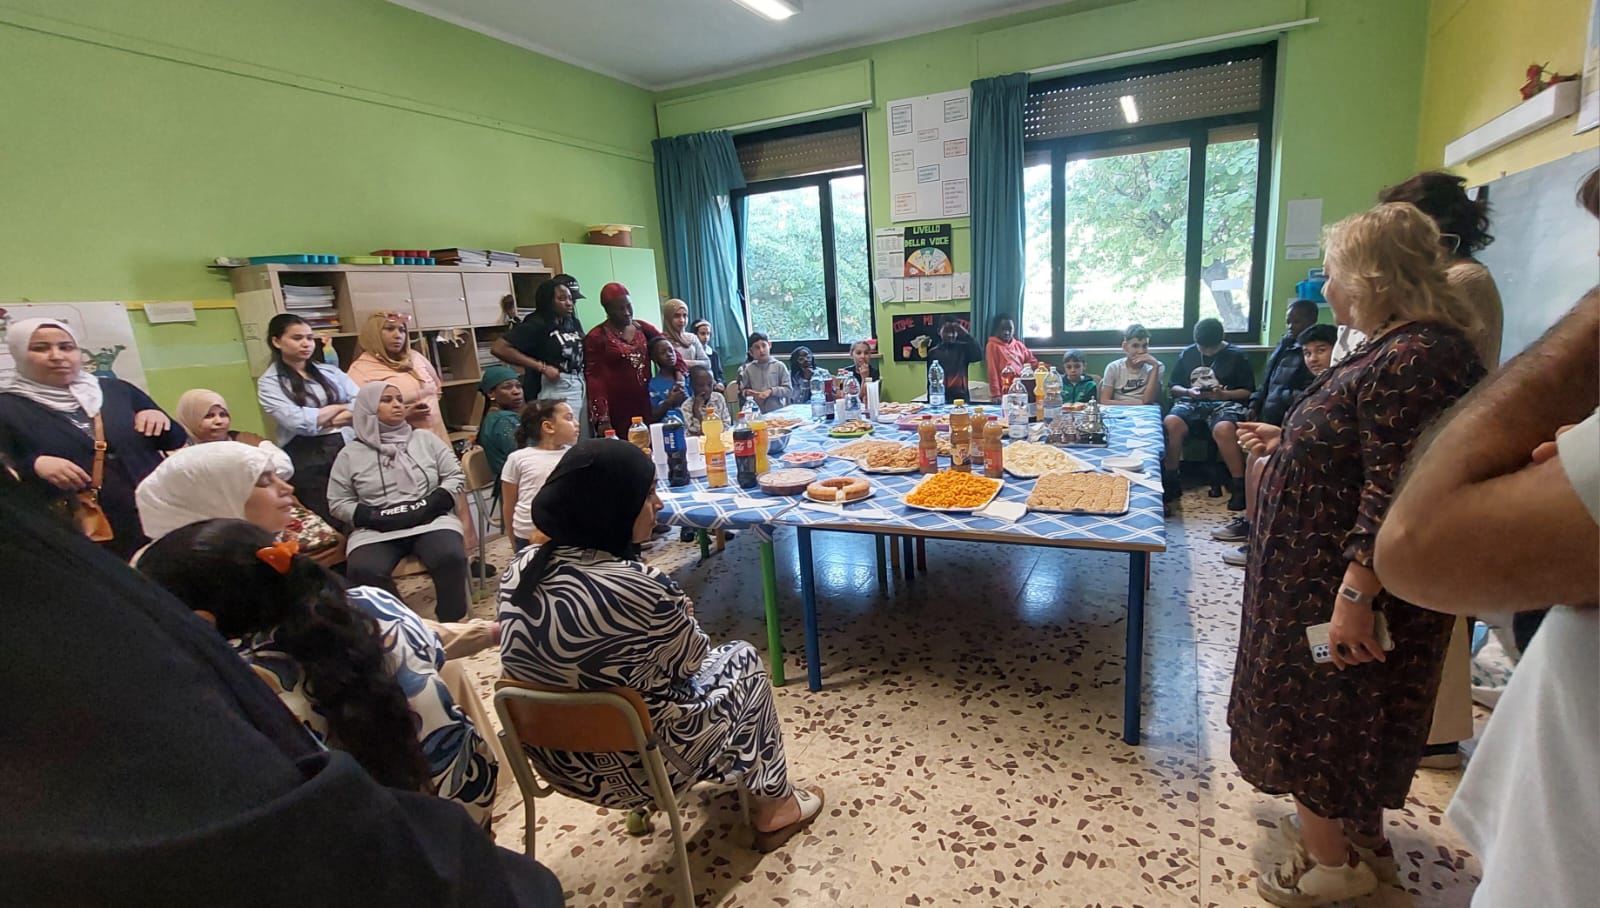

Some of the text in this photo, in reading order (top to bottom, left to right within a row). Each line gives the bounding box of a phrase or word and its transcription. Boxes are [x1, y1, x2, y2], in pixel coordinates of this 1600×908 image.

[912, 225, 941, 235] LIVELLO
[904, 236, 950, 248] DELLA VOCE
[1126, 379, 1145, 388] NIKE
[380, 504, 409, 517] FREE
